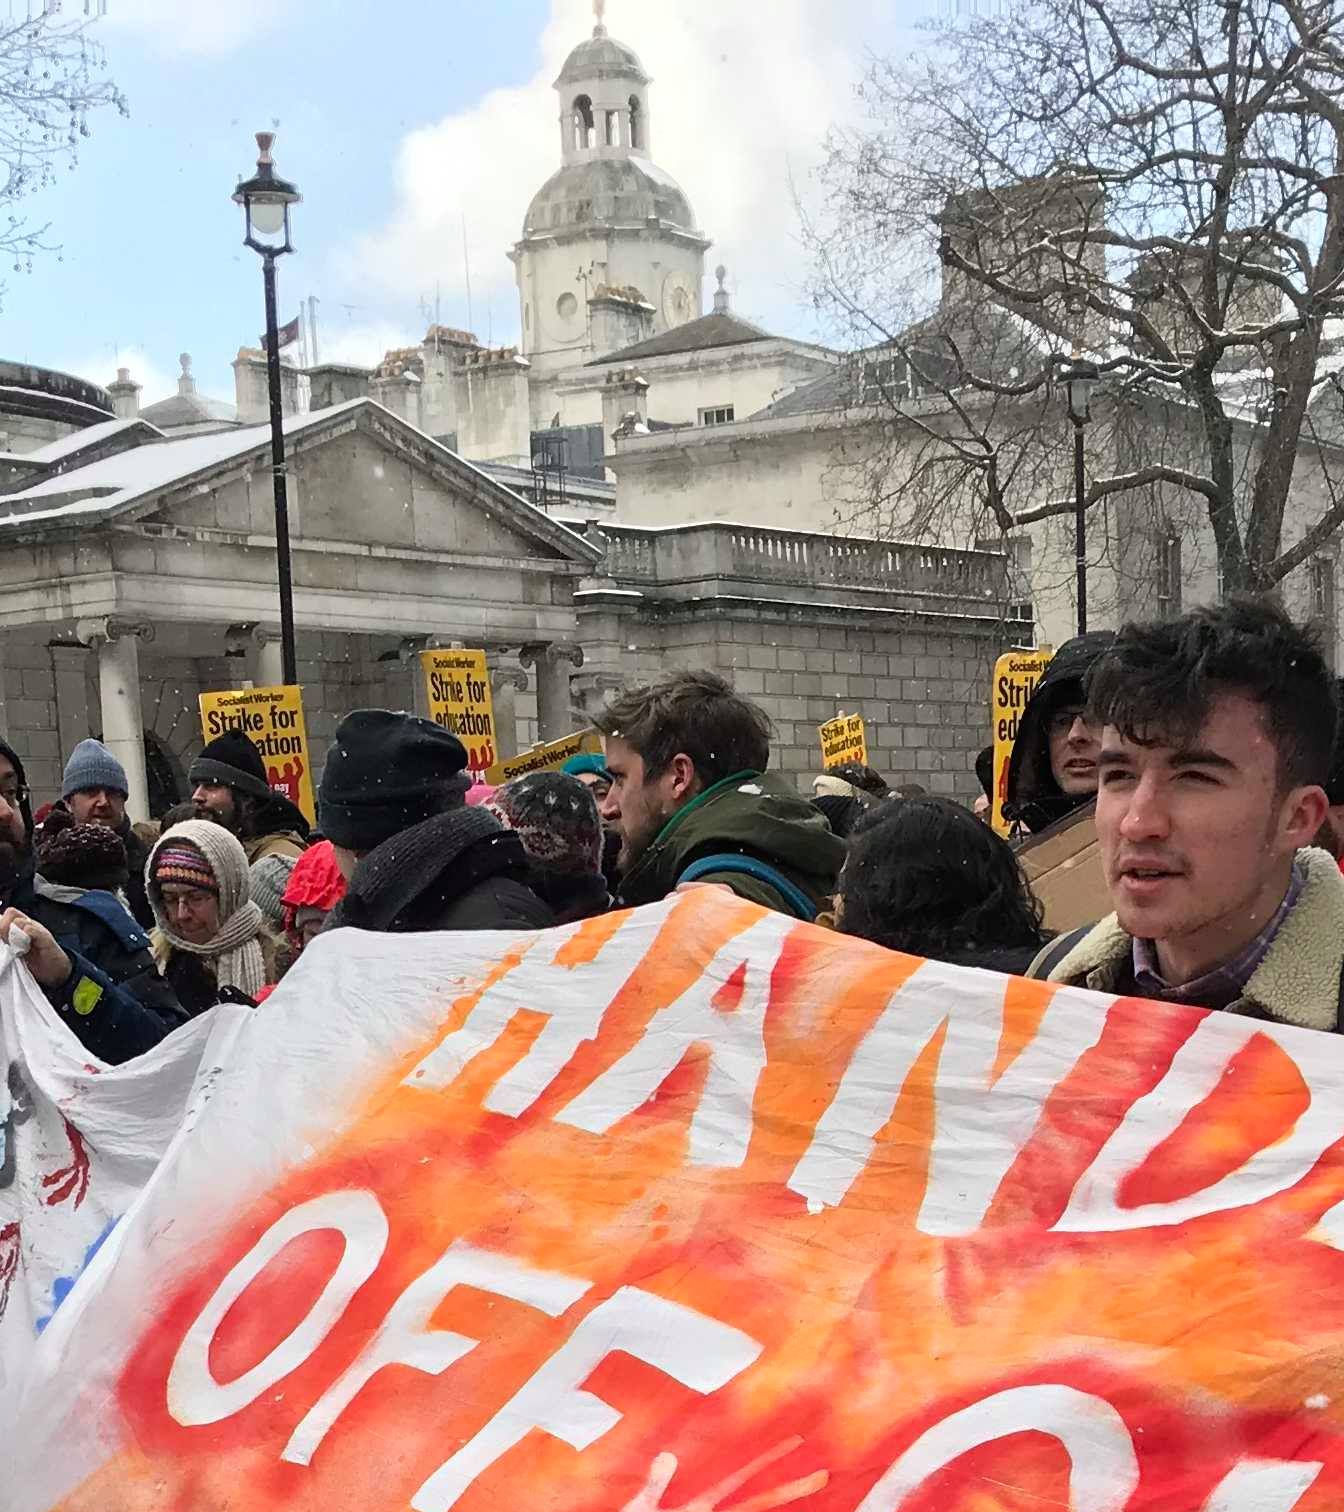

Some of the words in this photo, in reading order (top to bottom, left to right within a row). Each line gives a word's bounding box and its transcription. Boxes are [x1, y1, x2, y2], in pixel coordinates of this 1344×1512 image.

[216, 695, 254, 707] Socialist
[253, 692, 285, 704] Worker
[430, 672, 464, 703] Strike
[466, 672, 487, 704] for
[208, 707, 264, 736] Strike
[269, 705, 298, 730] for
[847, 718, 861, 733] for
[256, 731, 302, 757] ation
[503, 754, 548, 779] Socialist
